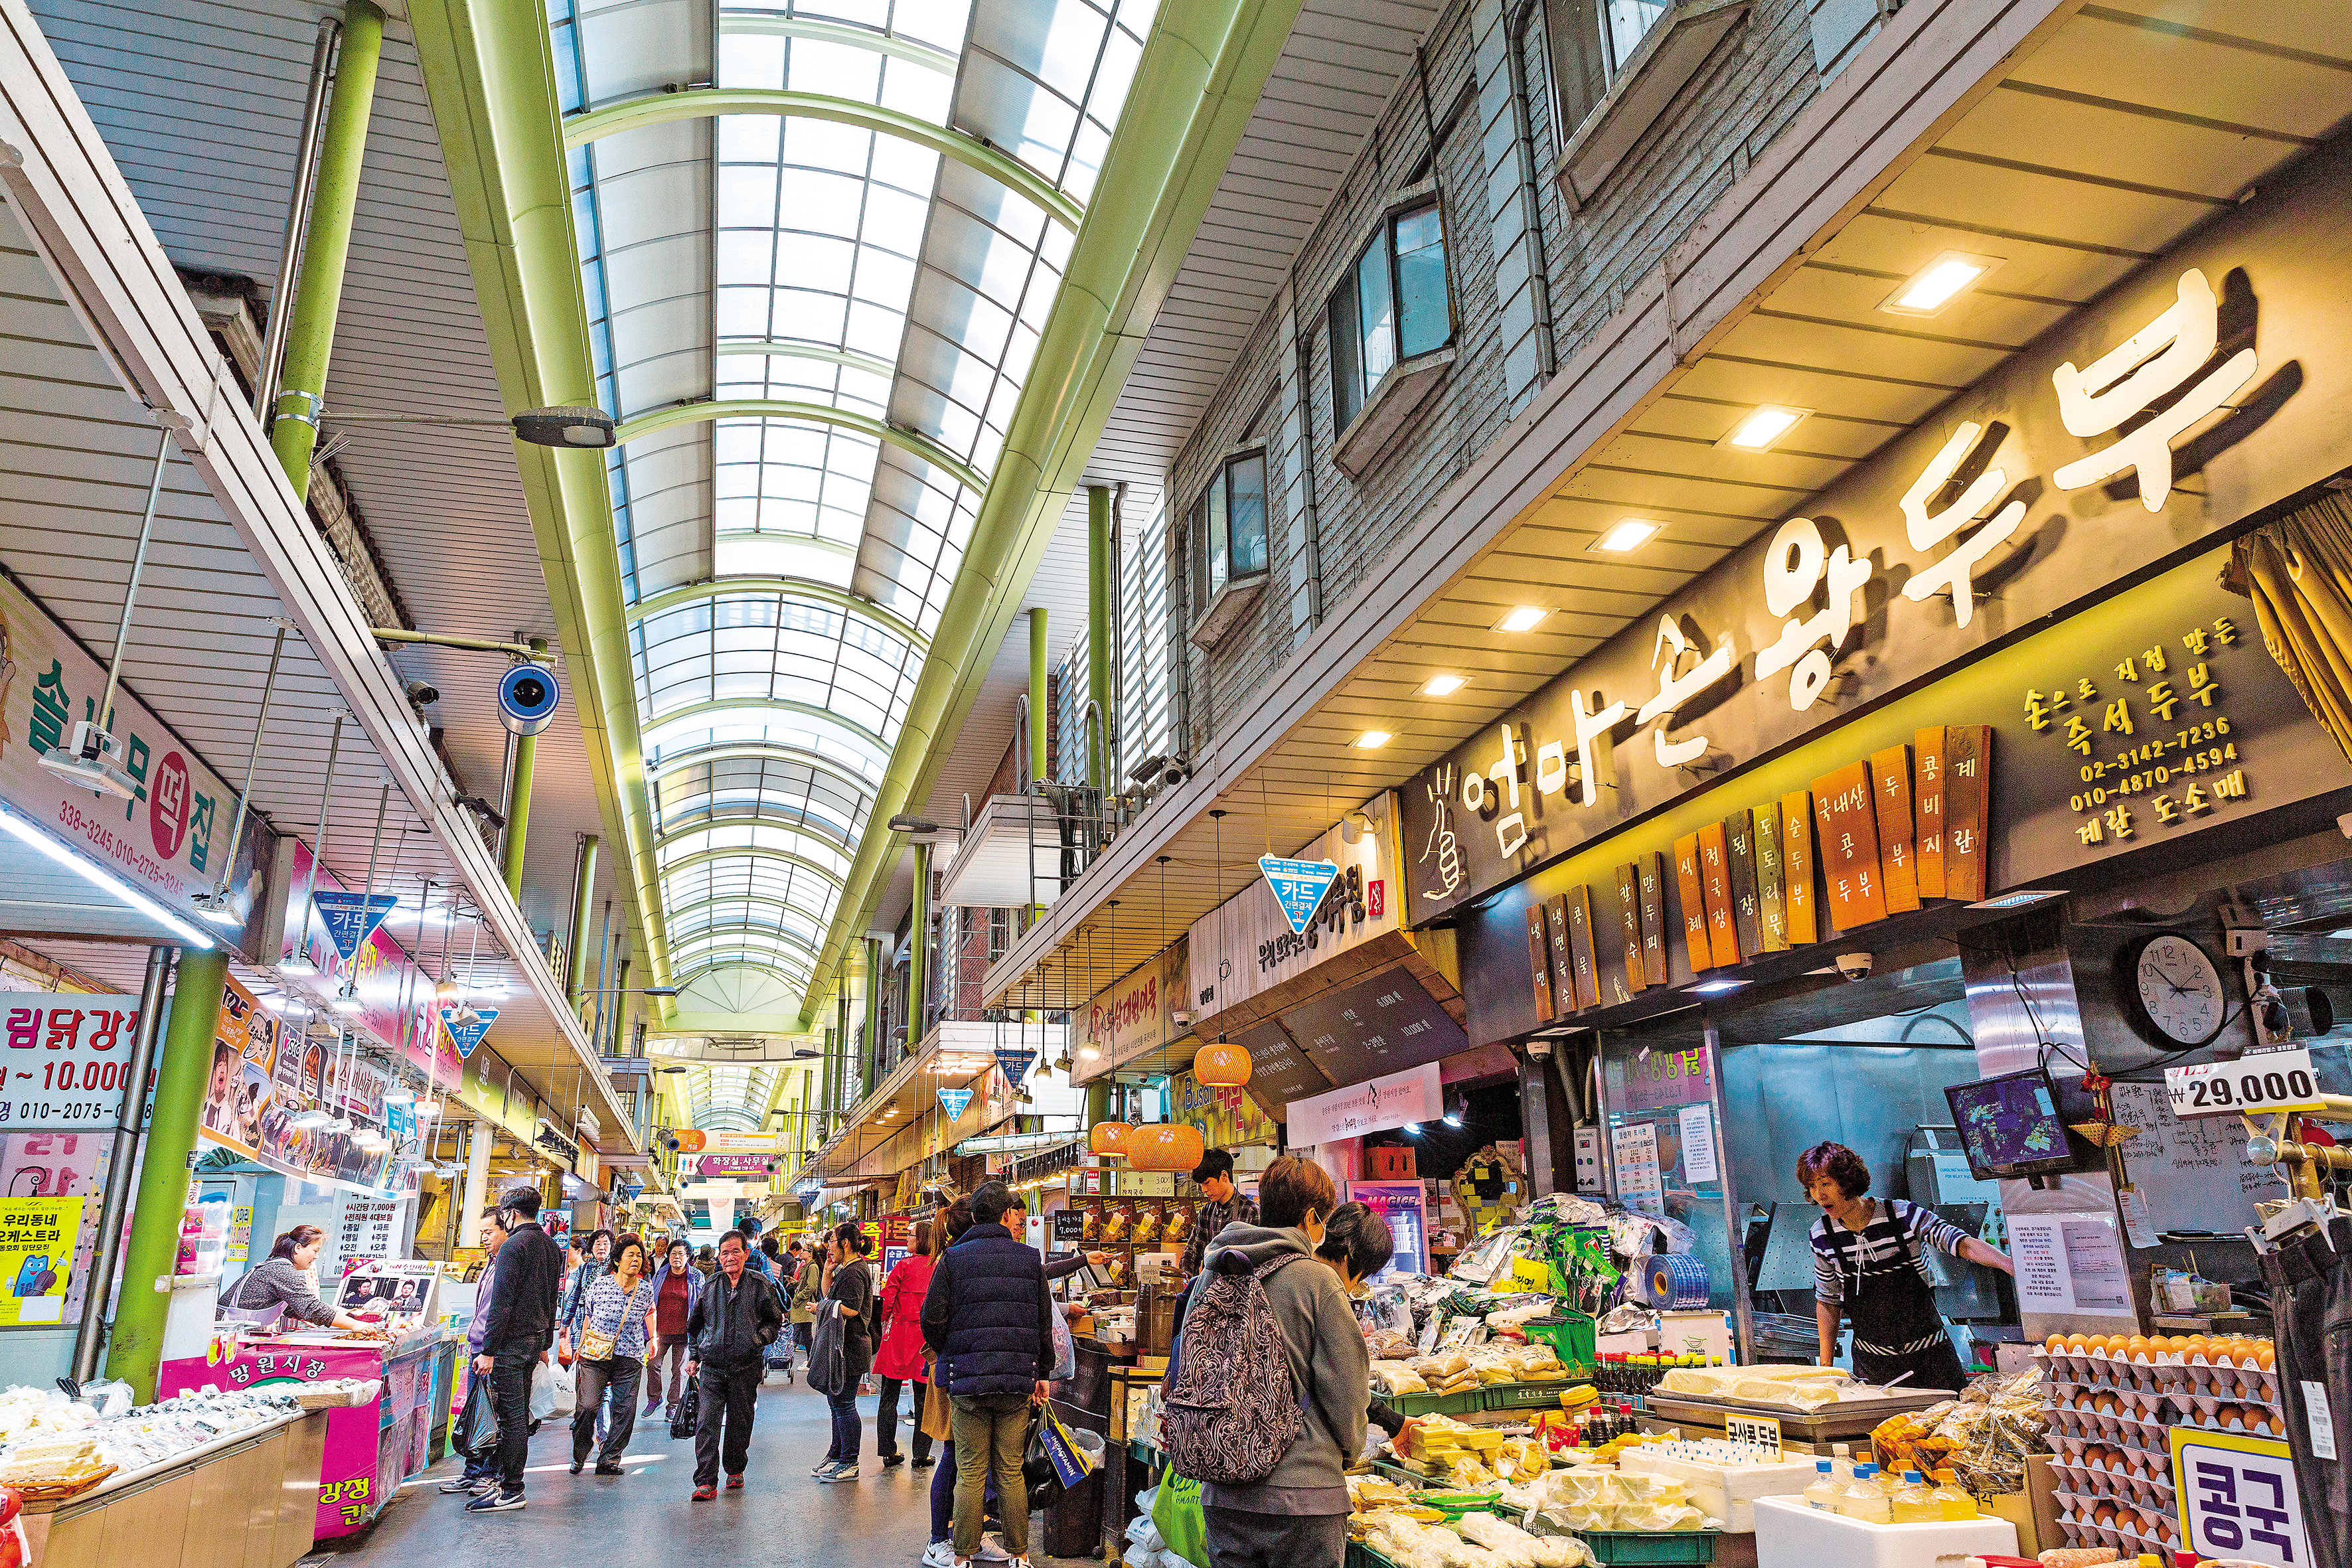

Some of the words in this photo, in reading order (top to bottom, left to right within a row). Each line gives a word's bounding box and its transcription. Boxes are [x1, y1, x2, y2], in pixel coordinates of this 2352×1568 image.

[2023, 677, 2096, 730] 손으로
[2114, 645, 2167, 681] 직접
[2182, 616, 2236, 655] 만든
[2080, 716, 2231, 783] 02-3142-7236
[2069, 742, 2238, 812] 010-4870-4594
[1818, 783, 1865, 821] 국내산
[1922, 755, 1941, 855] 콩비지
[1954, 757, 1976, 856] 계란
[1884, 776, 1905, 868] 두부
[2076, 803, 2133, 845] 계란
[1840, 834, 1853, 859] 콩
[1789, 816, 1806, 907] 순두부
[1732, 833, 1755, 917] 된장
[1759, 817, 1782, 937] 도토리묵
[1281, 882, 1316, 902] 카드
[1680, 858, 1702, 932] 식혜
[1705, 846, 1727, 929] 청국장
[1838, 870, 1873, 903] 두부
[1285, 900, 1312, 911] 간편결제
[1642, 874, 1658, 951] 만두피
[332, 912, 369, 931] 카드
[1618, 883, 1638, 960] 칼국수
[1573, 905, 1589, 973] 콩물
[1530, 921, 1547, 987] 냉면
[1551, 905, 1571, 1004] 냉면육수
[2161, 945, 2174, 959] 12
[2181, 951, 2188, 965] 1
[1376, 994, 1396, 1008] 6,000
[1393, 990, 1404, 1001] 원
[2201, 984, 2210, 999] 3
[1341, 1008, 1358, 1021] 1인분
[2148, 1000, 2158, 1014] 8
[2200, 1002, 2210, 1016] 4
[455, 1024, 481, 1036] 카드
[1401, 1022, 1423, 1036] 10,000
[1422, 1018, 1433, 1030] 원
[2162, 1015, 2171, 1030] 7
[2179, 1021, 2189, 1036] 6
[2193, 1017, 2203, 1032] 5
[1362, 1035, 1387, 1050] 2~3인분
[1005, 1062, 1024, 1072] 카드
[947, 1099, 963, 1108] 카드
[1184, 1076, 1215, 1112] Busan
[688, 1131, 699, 1144] 愛
[350, 1203, 369, 1212] 시간당
[370, 1203, 396, 1212] 7,000원
[3, 1214, 58, 1227] 우리동네
[346, 1223, 360, 1232] 종일
[348, 1214, 368, 1222] 전직원
[0, 1229, 60, 1243] 오케스트라
[345, 1233, 358, 1242] 평일
[343, 1243, 357, 1252] 오전
[228, 1354, 327, 1383] 망원시장
[319, 1478, 370, 1504] 강정
